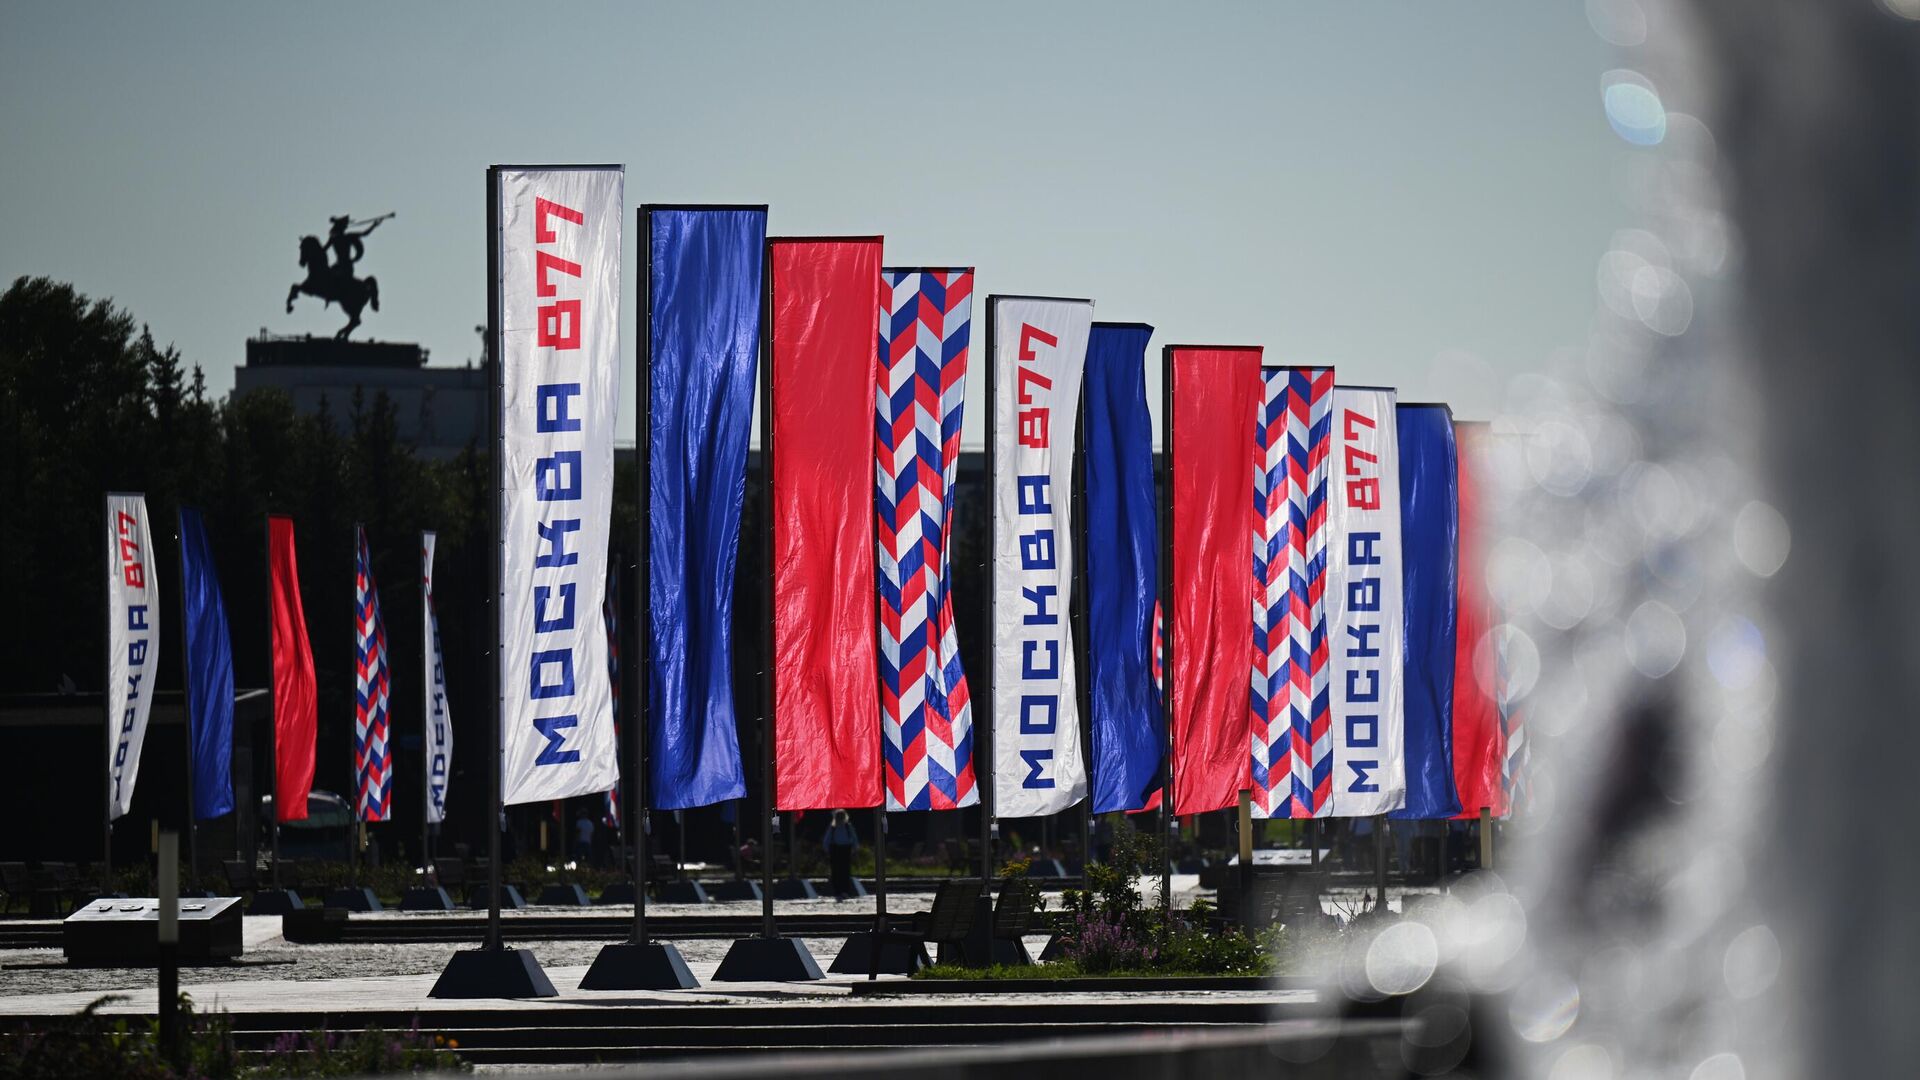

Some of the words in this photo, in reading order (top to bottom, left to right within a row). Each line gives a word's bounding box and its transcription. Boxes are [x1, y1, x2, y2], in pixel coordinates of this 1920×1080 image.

[535, 196, 584, 351] 877
[1017, 323, 1058, 449] 877
[1343, 409, 1381, 511] 877
[118, 510, 145, 588] 877
[531, 383, 583, 767] МОСКВА
[1017, 474, 1060, 790] МОСКВА
[1345, 531, 1382, 794] МОСКВА
